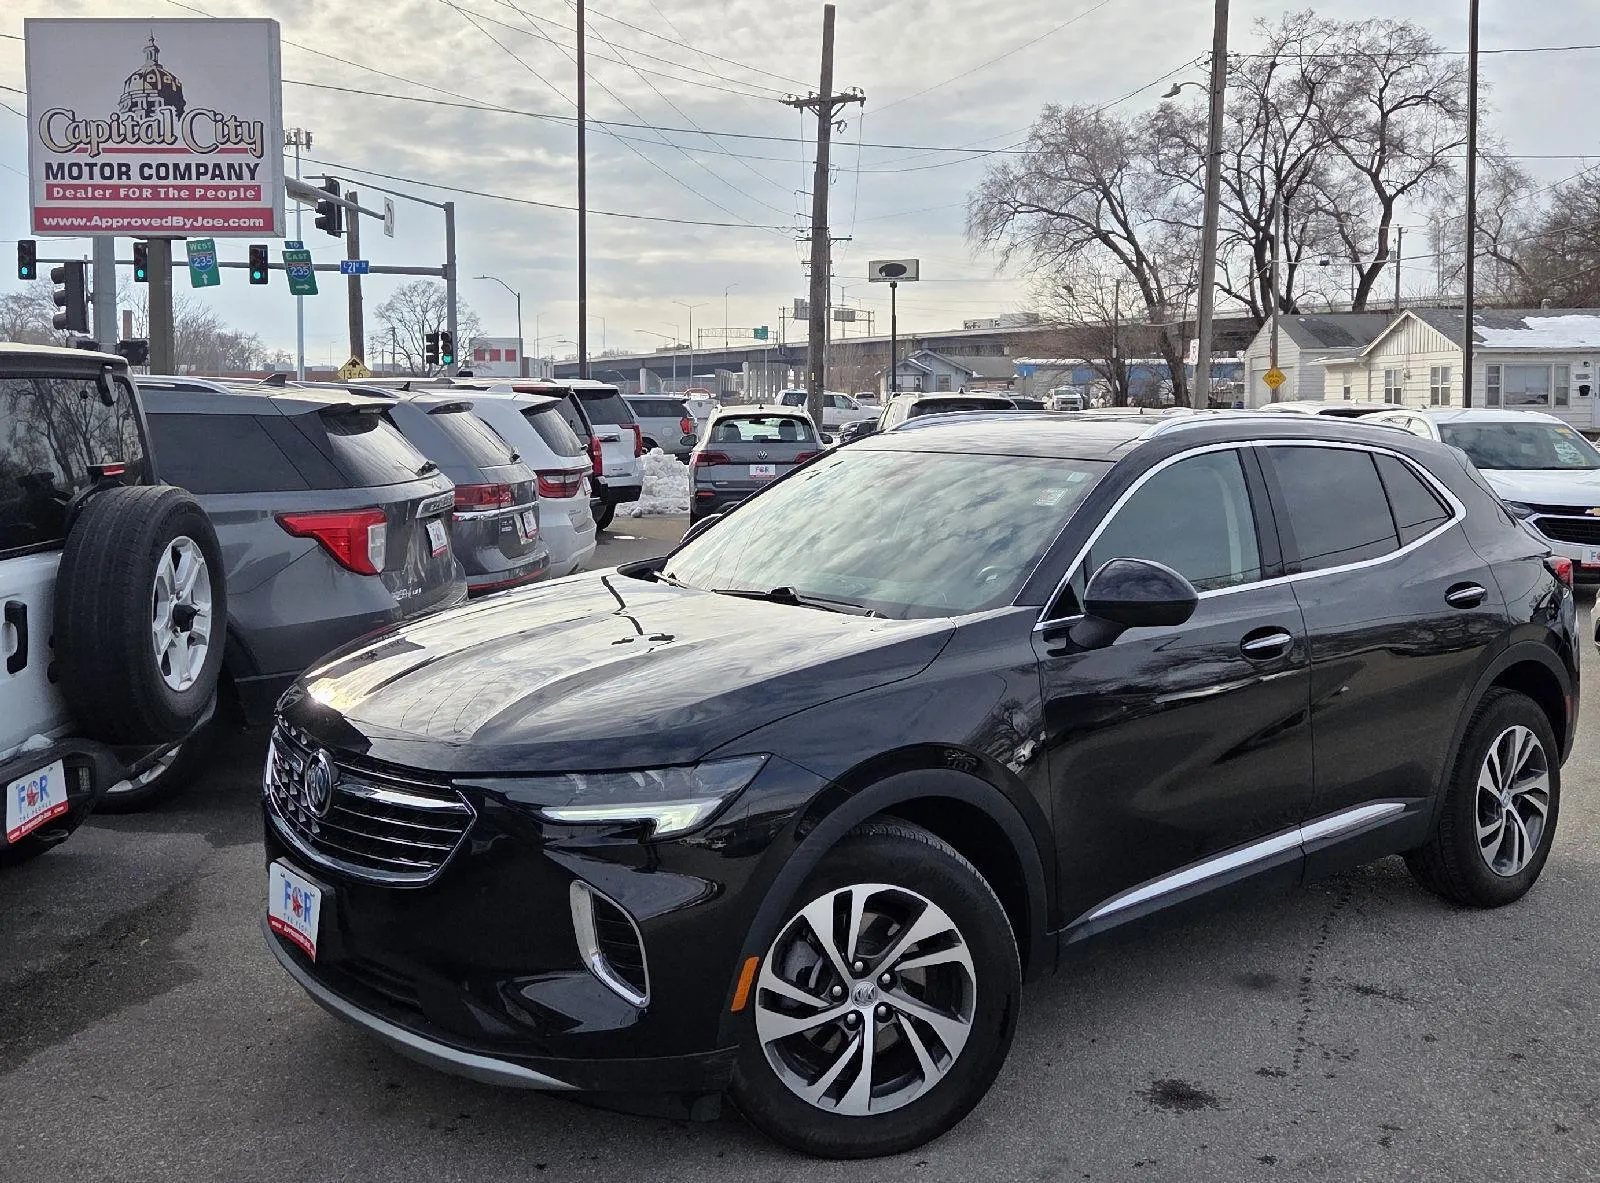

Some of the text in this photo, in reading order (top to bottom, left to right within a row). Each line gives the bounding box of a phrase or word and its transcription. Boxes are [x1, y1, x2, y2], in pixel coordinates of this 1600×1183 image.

[38, 106, 265, 159] Capital City
[45, 162, 260, 181] MOTOR COMPANY
[53, 187, 113, 198] Dealer
[119, 188, 152, 198] FOR
[157, 188, 190, 198] The
[43, 215, 264, 229] www.ApprovedByJoe.com
[189, 242, 212, 251] WEST
[193, 255, 213, 267] 235
[285, 252, 307, 260] EAST
[289, 266, 310, 276] 235
[284, 879, 311, 926] FOR
